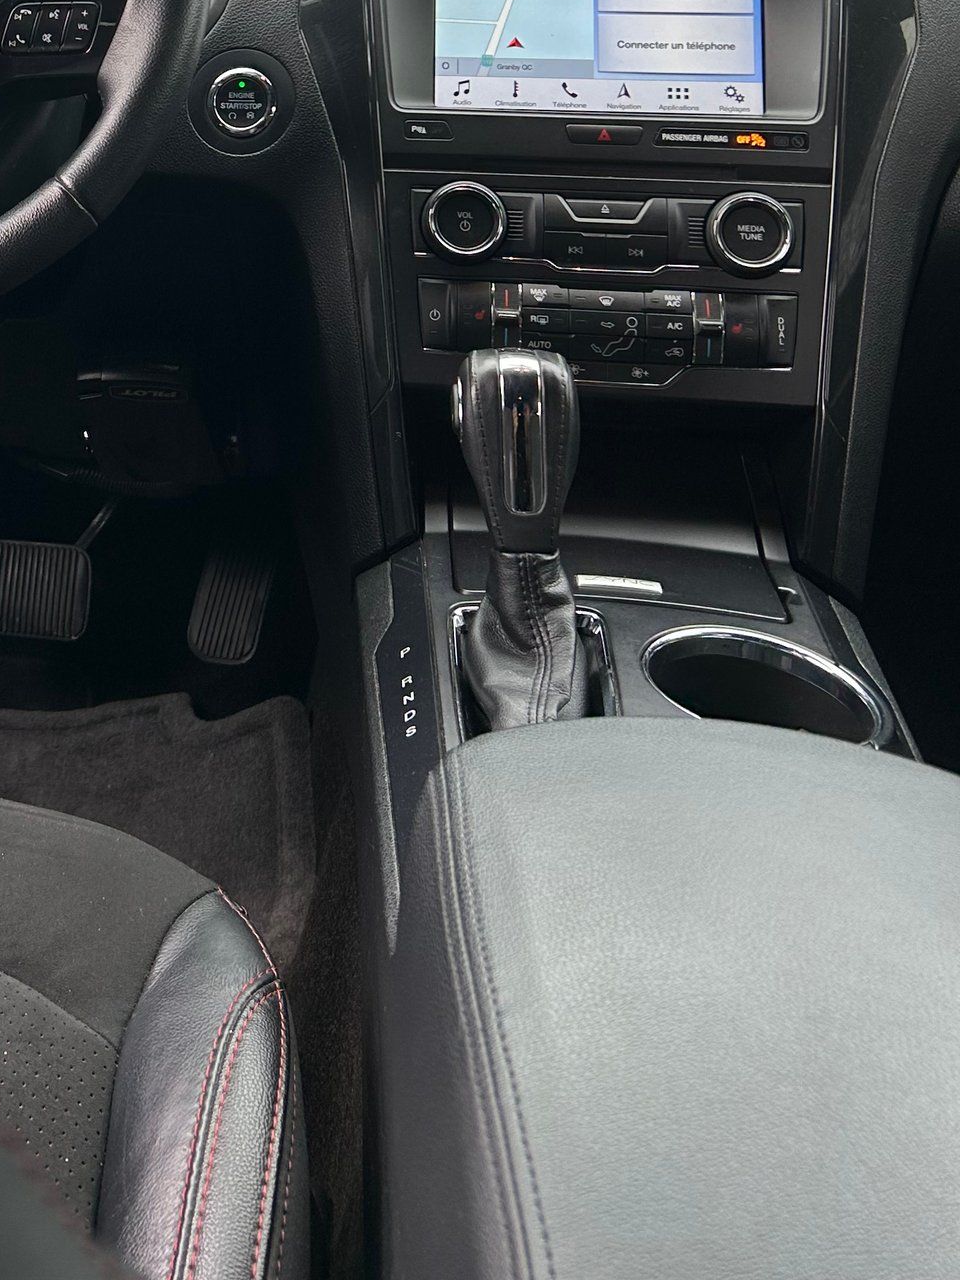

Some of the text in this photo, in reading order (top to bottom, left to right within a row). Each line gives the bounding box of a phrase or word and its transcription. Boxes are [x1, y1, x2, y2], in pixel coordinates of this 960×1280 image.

[77, 23, 89, 31] VOL
[617, 40, 736, 52] Connecter un téléphone
[496, 63, 520, 72] Granby
[228, 91, 255, 99] ENGINE
[220, 102, 263, 110] START/STOP
[494, 99, 537, 107] Climatisation
[552, 100, 587, 109] Téléphone
[606, 103, 642, 111] Navigation
[658, 104, 699, 112] Applications
[718, 104, 751, 113] Réglages
[661, 133, 702, 142] PASSENGER
[703, 134, 729, 143] AIRBAG
[457, 211, 473, 219] VOL
[737, 224, 765, 233] MEDIA
[739, 233, 764, 241] TUNE
[530, 289, 547, 297] MAX
[667, 322, 683, 330] A/C
[528, 340, 551, 349] AUTO
[400, 646, 411, 659] P
[401, 674, 413, 688] R
[403, 691, 416, 705] N
[404, 709, 417, 723] D
[405, 724, 417, 737] S
